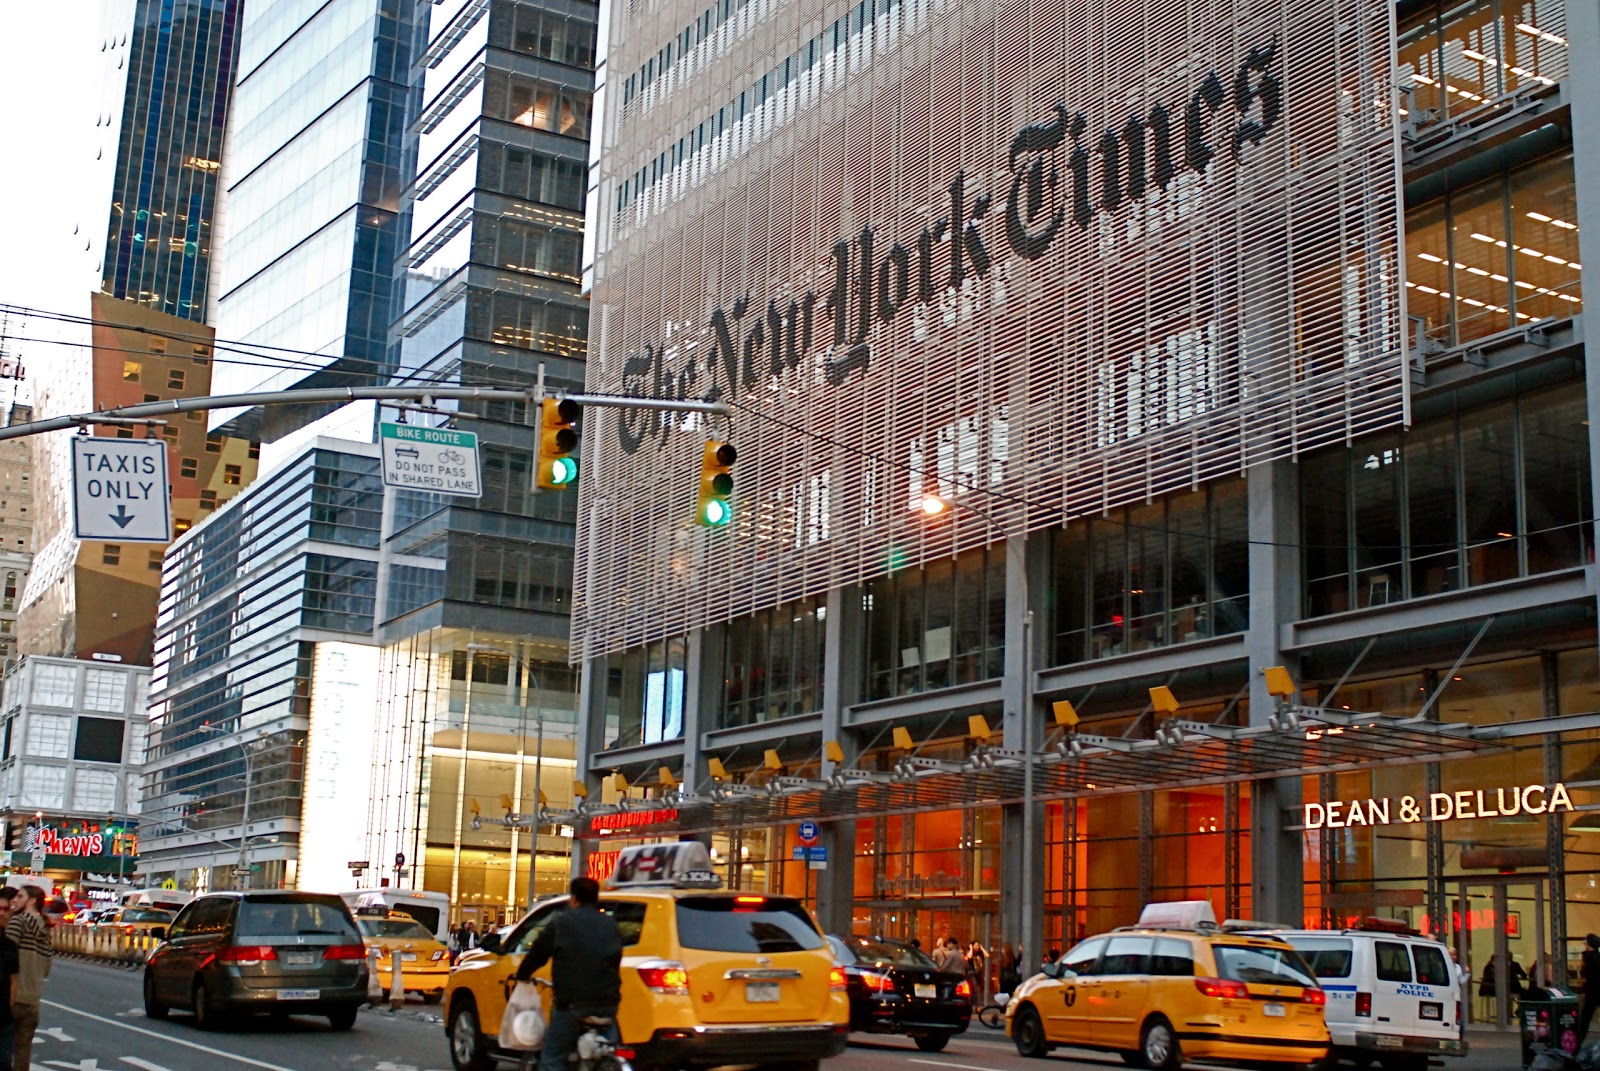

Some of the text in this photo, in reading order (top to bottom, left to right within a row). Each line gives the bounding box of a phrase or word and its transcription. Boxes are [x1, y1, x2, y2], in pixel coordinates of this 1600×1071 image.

[618, 31, 1282, 455] The New York Times
[396, 427, 460, 444] BIKE ROUTE
[83, 453, 155, 474] TAXIS
[396, 460, 466, 478] DO NOT PASS
[88, 480, 153, 499] ONLY
[389, 472, 475, 491] IN SHARED LANE
[1304, 782, 1575, 829] DEAN & DELUCA
[1396, 988, 1434, 998] POLICE
[1400, 983, 1429, 991] NYPD
